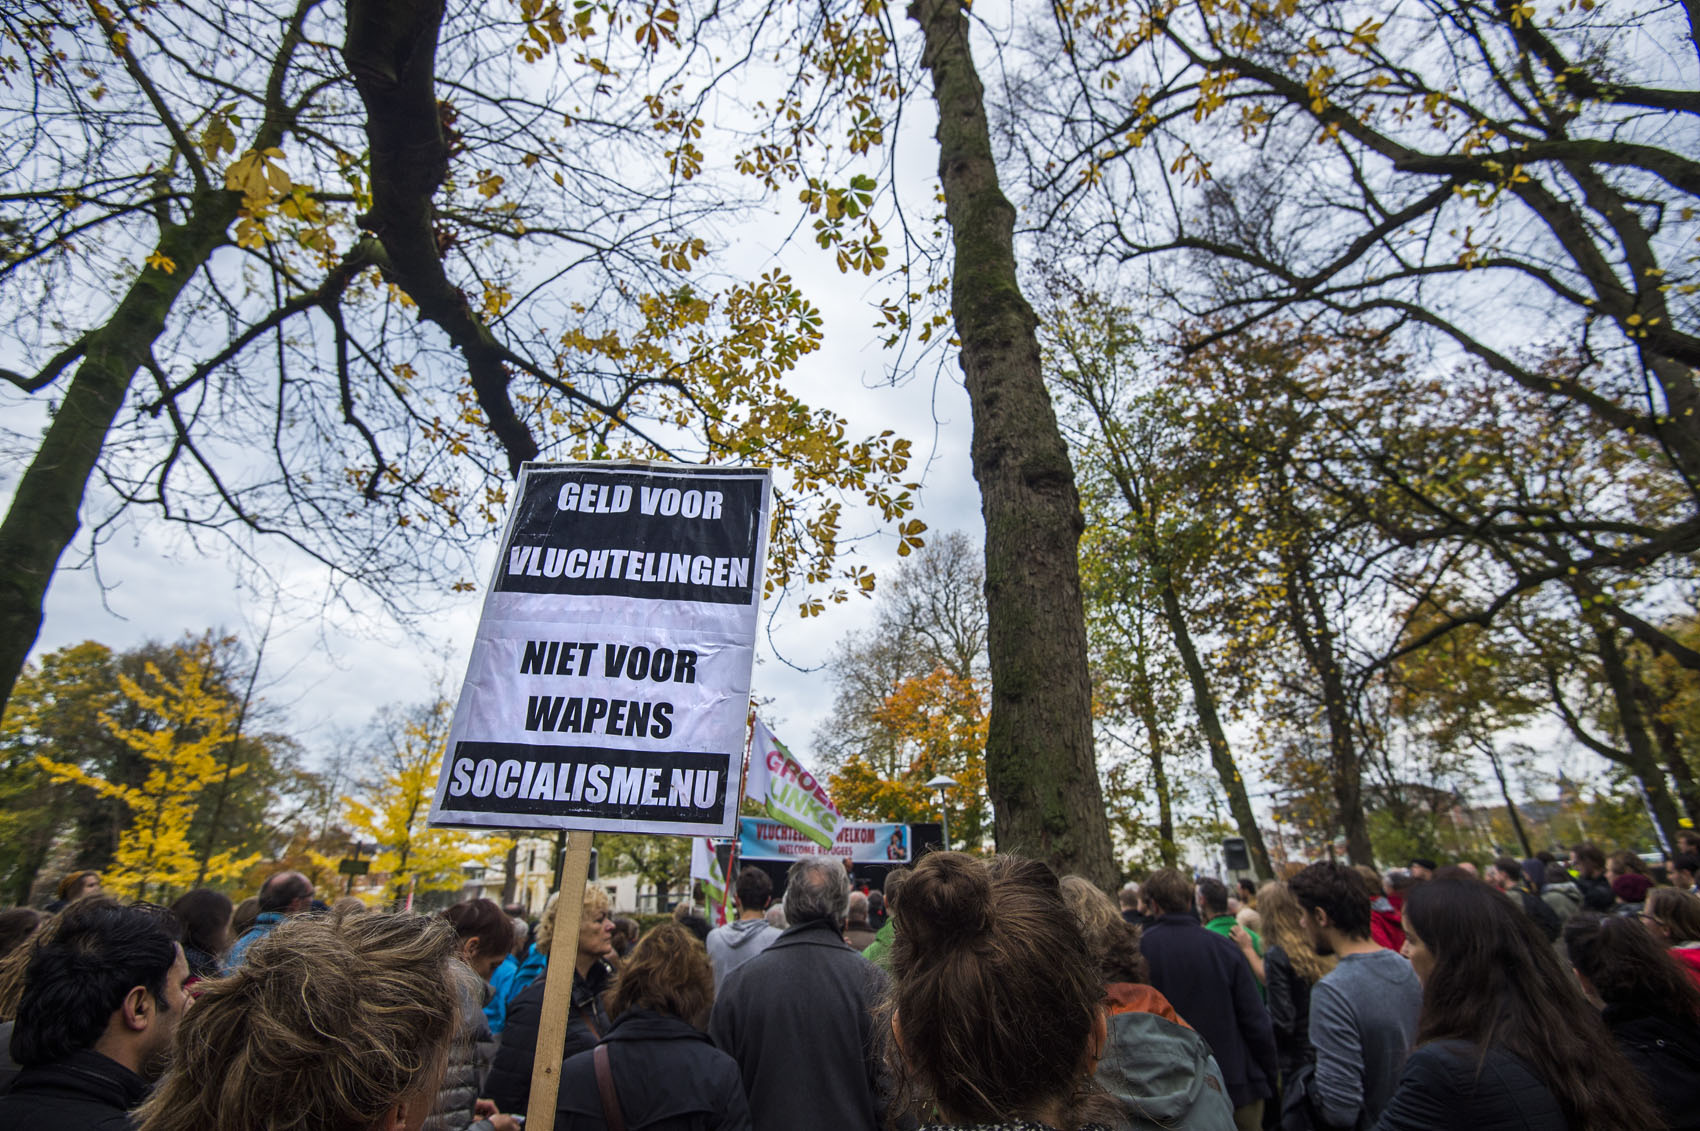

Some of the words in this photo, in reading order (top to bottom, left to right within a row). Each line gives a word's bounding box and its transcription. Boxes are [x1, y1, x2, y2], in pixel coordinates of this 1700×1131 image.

[557, 482, 633, 514] GELD
[639, 486, 724, 520] VOOR
[508, 545, 750, 588] VLUCHTELINGEN
[519, 640, 598, 677] NIET
[603, 643, 698, 684] VOOR
[524, 695, 674, 740] WAPENS
[449, 757, 719, 809] SOCIALISME.NU
[771, 776, 838, 833] LINKS
[778, 844, 816, 856] WELCOME
